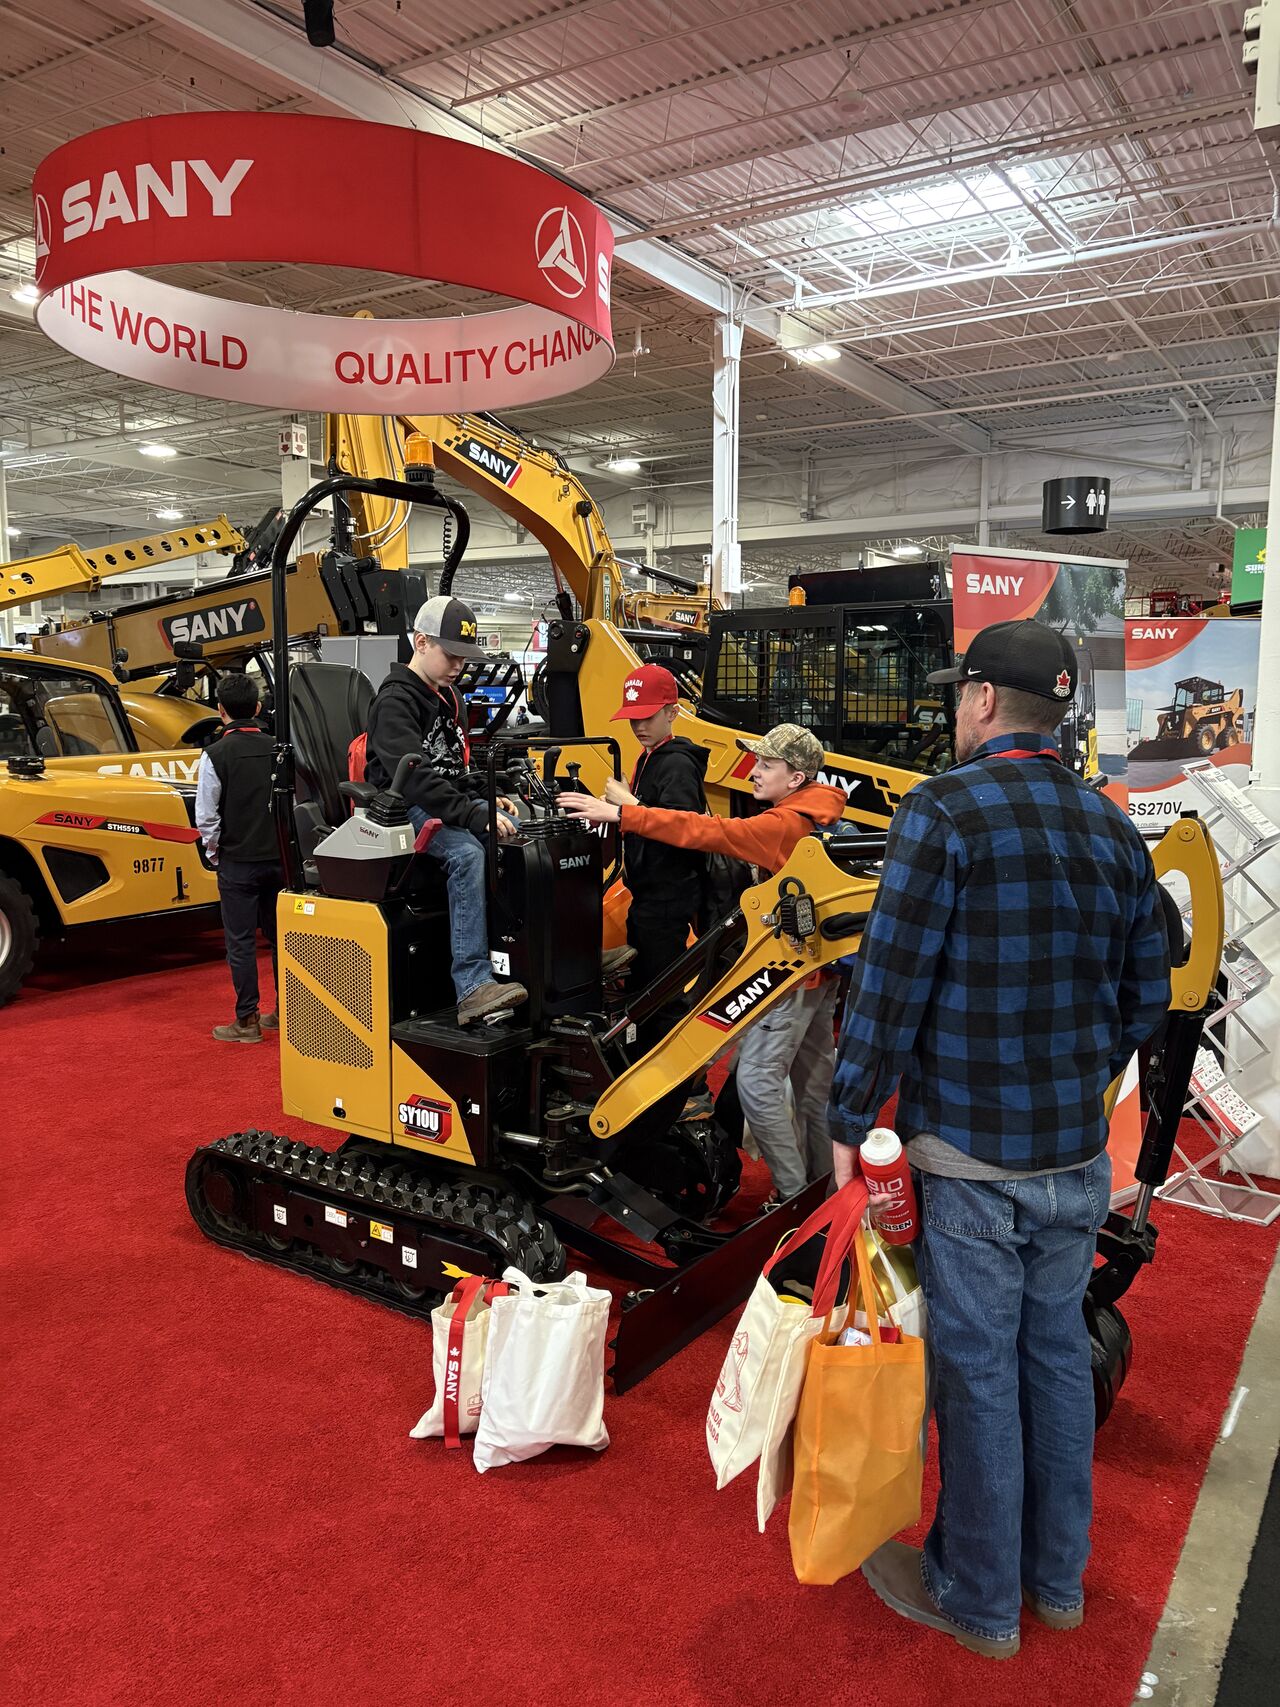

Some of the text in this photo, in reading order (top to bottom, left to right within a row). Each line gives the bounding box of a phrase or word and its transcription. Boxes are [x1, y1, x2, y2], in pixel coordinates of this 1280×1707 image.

[61, 159, 255, 243] SANY
[109, 300, 248, 371] WORLD
[335, 322, 601, 386] QUALITY CHANG
[468, 442, 512, 479] SANY
[966, 573, 1024, 596] SANY
[170, 603, 248, 647] SANY
[675, 611, 695, 624] SANY
[460, 620, 476, 637] M
[1132, 627, 1178, 640] SANY
[625, 679, 643, 688] CANADA
[54, 813, 140, 833] SANY STH5519
[359, 826, 380, 840] SANY
[133, 857, 165, 874] 9877
[559, 854, 591, 870] SANY
[725, 970, 772, 1020] SANY
[399, 1103, 439, 1131] SY10U
[879, 1219, 911, 1231] ENSEN
[446, 1360, 459, 1403] SANY
